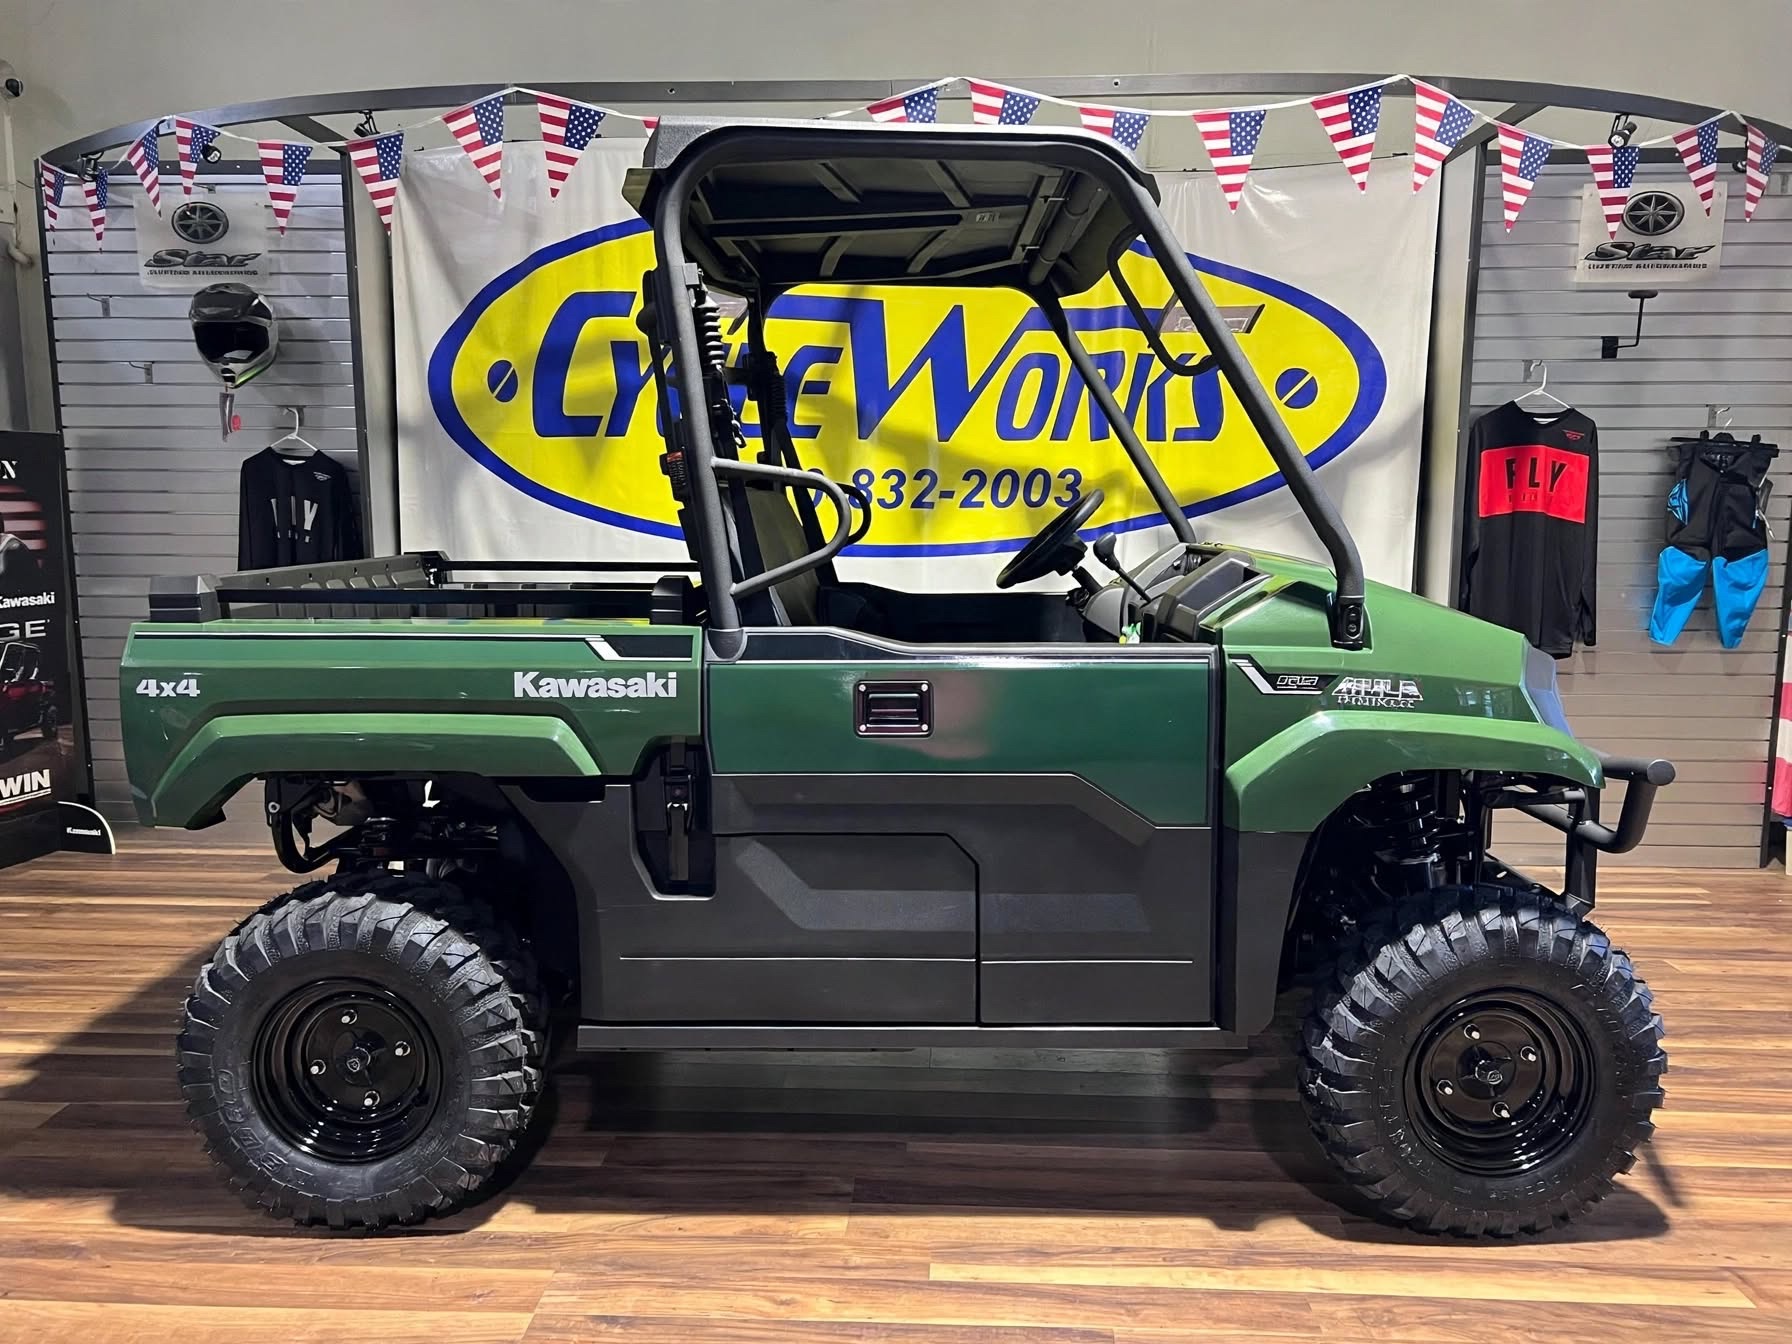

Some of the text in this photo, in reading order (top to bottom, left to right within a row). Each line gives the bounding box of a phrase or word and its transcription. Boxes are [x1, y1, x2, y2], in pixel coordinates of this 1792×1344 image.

[1505, 457, 1567, 499] FLY
[136, 679, 200, 697] 4x4
[513, 671, 677, 698] Kawasaki
[0, 769, 51, 798] WIN
